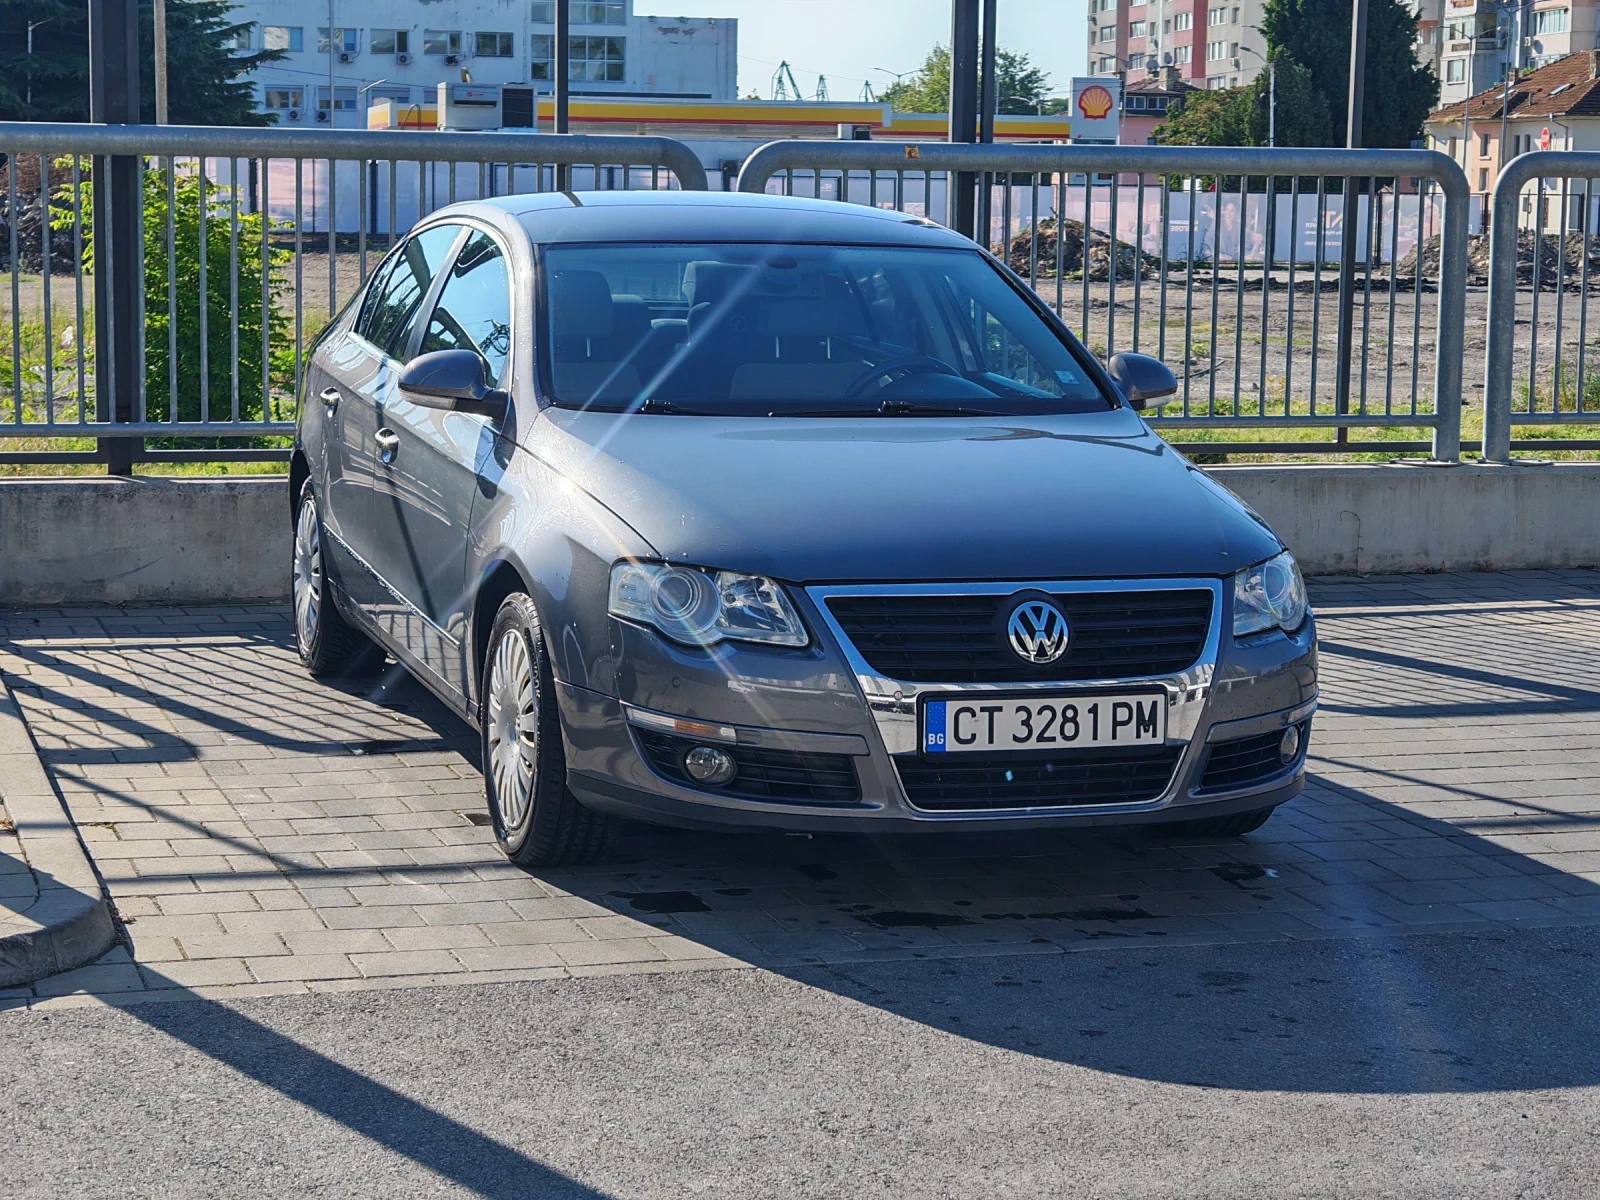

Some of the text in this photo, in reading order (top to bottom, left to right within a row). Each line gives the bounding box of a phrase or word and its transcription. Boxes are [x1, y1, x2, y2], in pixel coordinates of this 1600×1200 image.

[953, 700, 1158, 745] CT 3281 PM
[928, 733, 944, 745] BG
